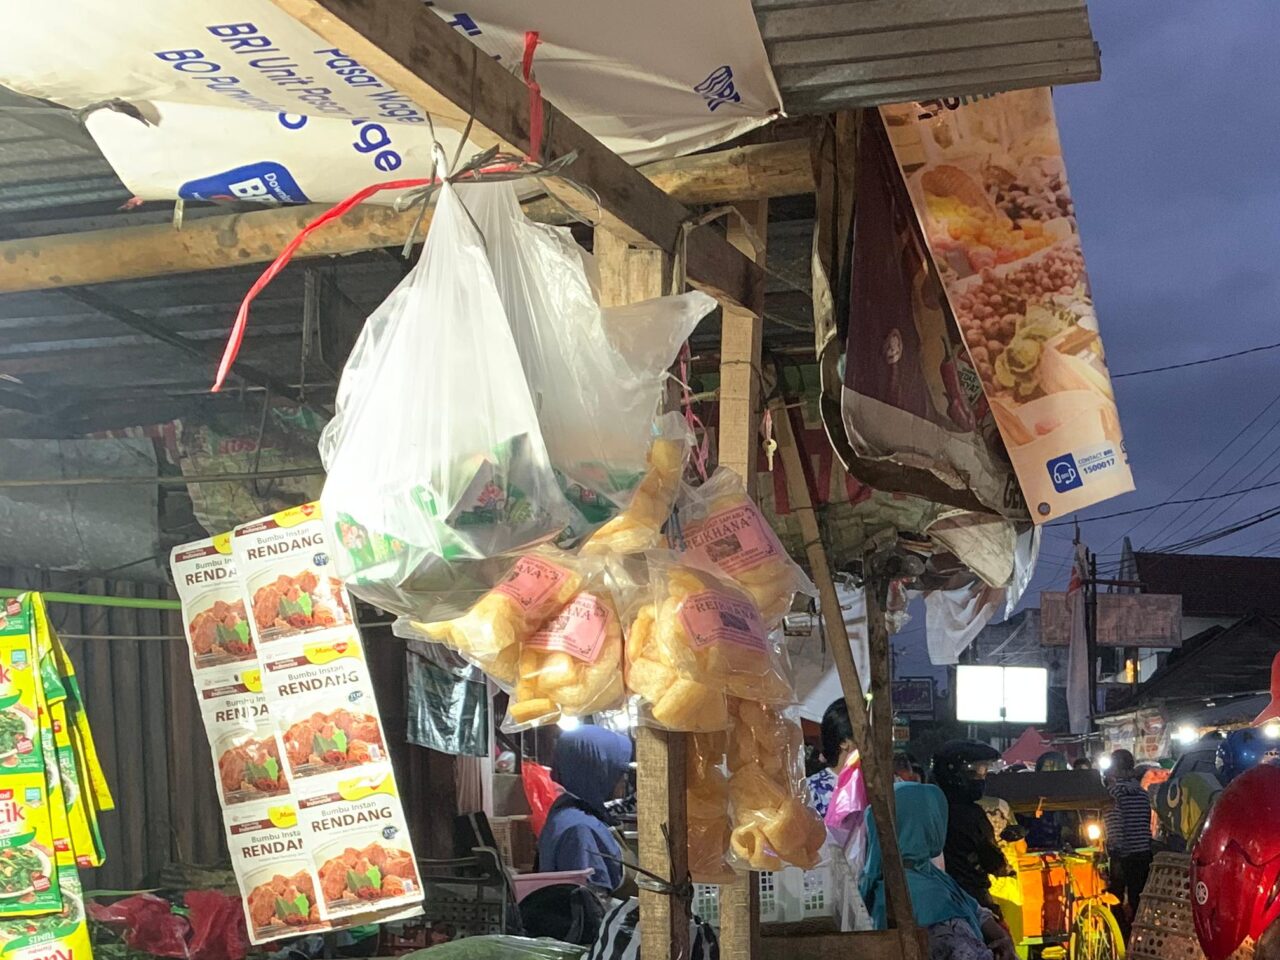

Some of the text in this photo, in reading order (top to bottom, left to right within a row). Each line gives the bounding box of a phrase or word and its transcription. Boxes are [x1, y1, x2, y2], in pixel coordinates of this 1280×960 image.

[154, 49, 221, 73] BO
[206, 22, 281, 54] BRI
[249, 56, 316, 86] Unit
[1083, 458, 1115, 475] 1500017
[247, 533, 324, 560] RENDANG
[195, 559, 223, 570] Bumbu
[185, 567, 237, 586] RENDA
[288, 670, 317, 681] Bumbu
[321, 801, 376, 817] Bumbu Instan
[311, 807, 392, 833] RENDANG
[251, 832, 280, 843] Bumbu
